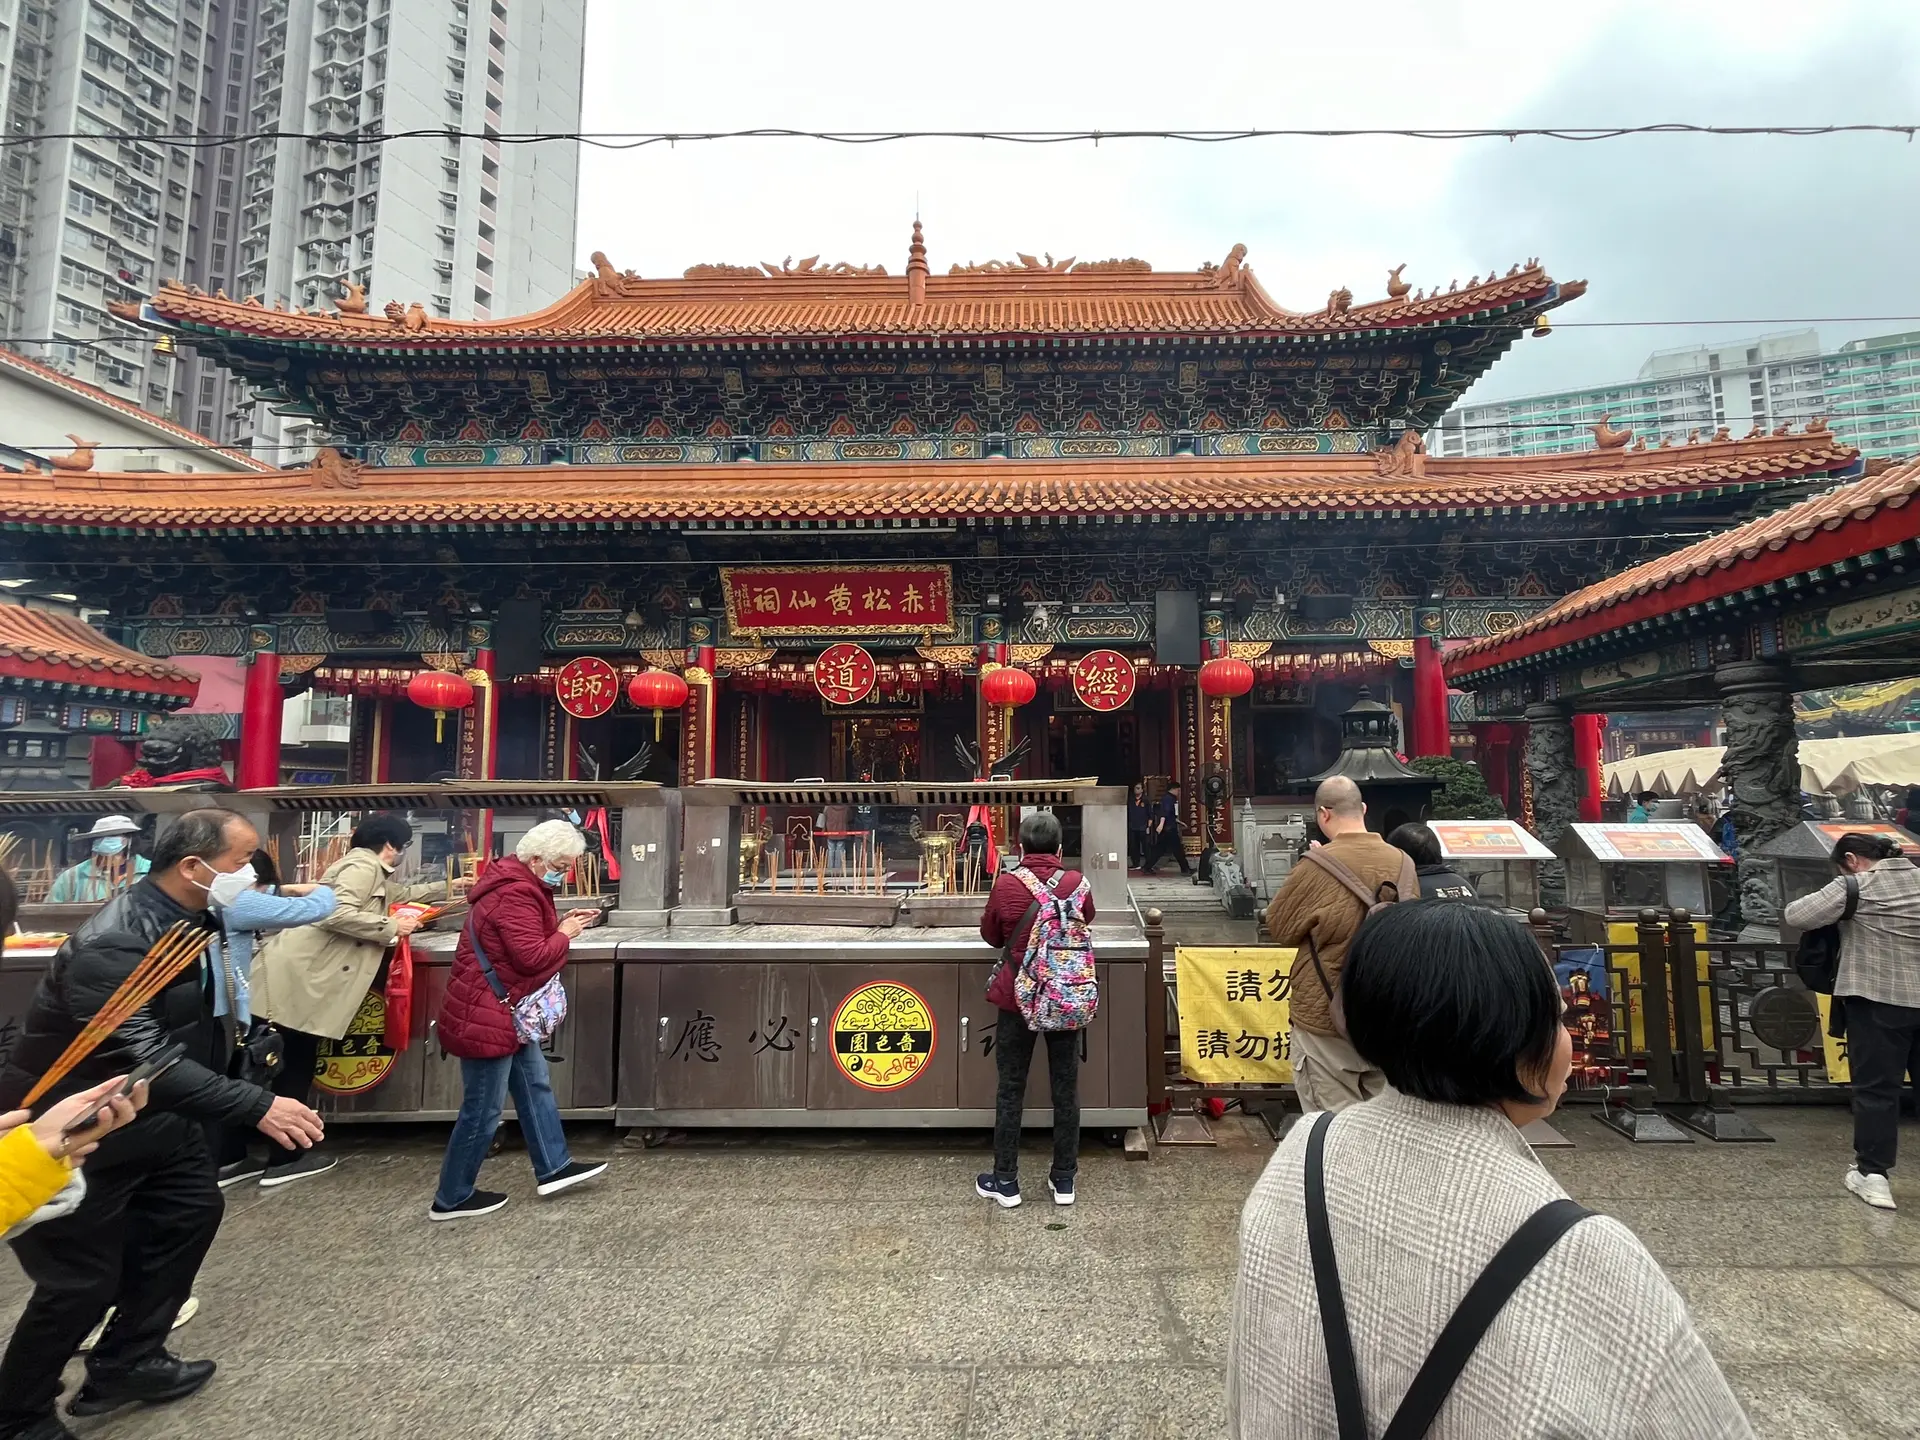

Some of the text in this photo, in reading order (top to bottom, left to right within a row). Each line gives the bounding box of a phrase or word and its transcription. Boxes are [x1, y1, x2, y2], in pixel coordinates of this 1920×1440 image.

[570, 670, 602, 704] 師
[827, 655, 862, 692] 道
[1085, 665, 1119, 695] 經
